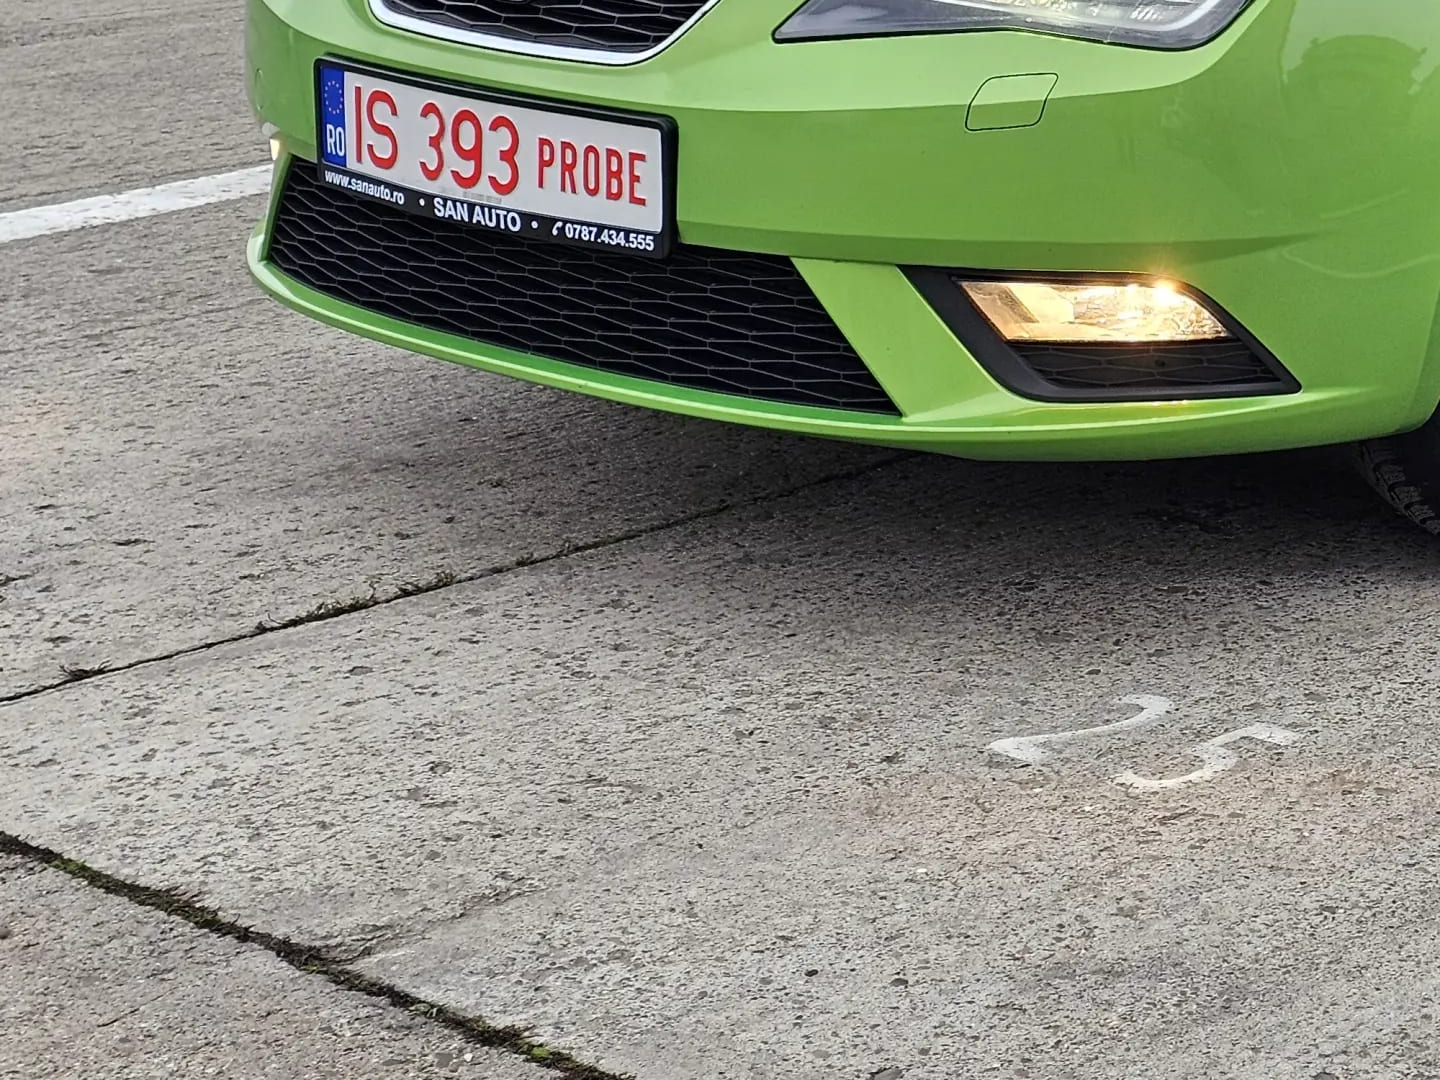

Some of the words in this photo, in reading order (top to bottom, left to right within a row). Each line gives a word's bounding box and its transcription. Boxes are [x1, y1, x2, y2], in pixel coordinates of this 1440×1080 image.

[326, 123, 345, 157] RO
[354, 85, 399, 169] IS
[419, 101, 520, 196] 393
[538, 136, 647, 207] PROBE
[325, 170, 405, 205] www.sanauto.ro
[433, 197, 469, 222] SAN
[472, 205, 521, 233] AUTO
[564, 222, 655, 251] 0787.434.555
